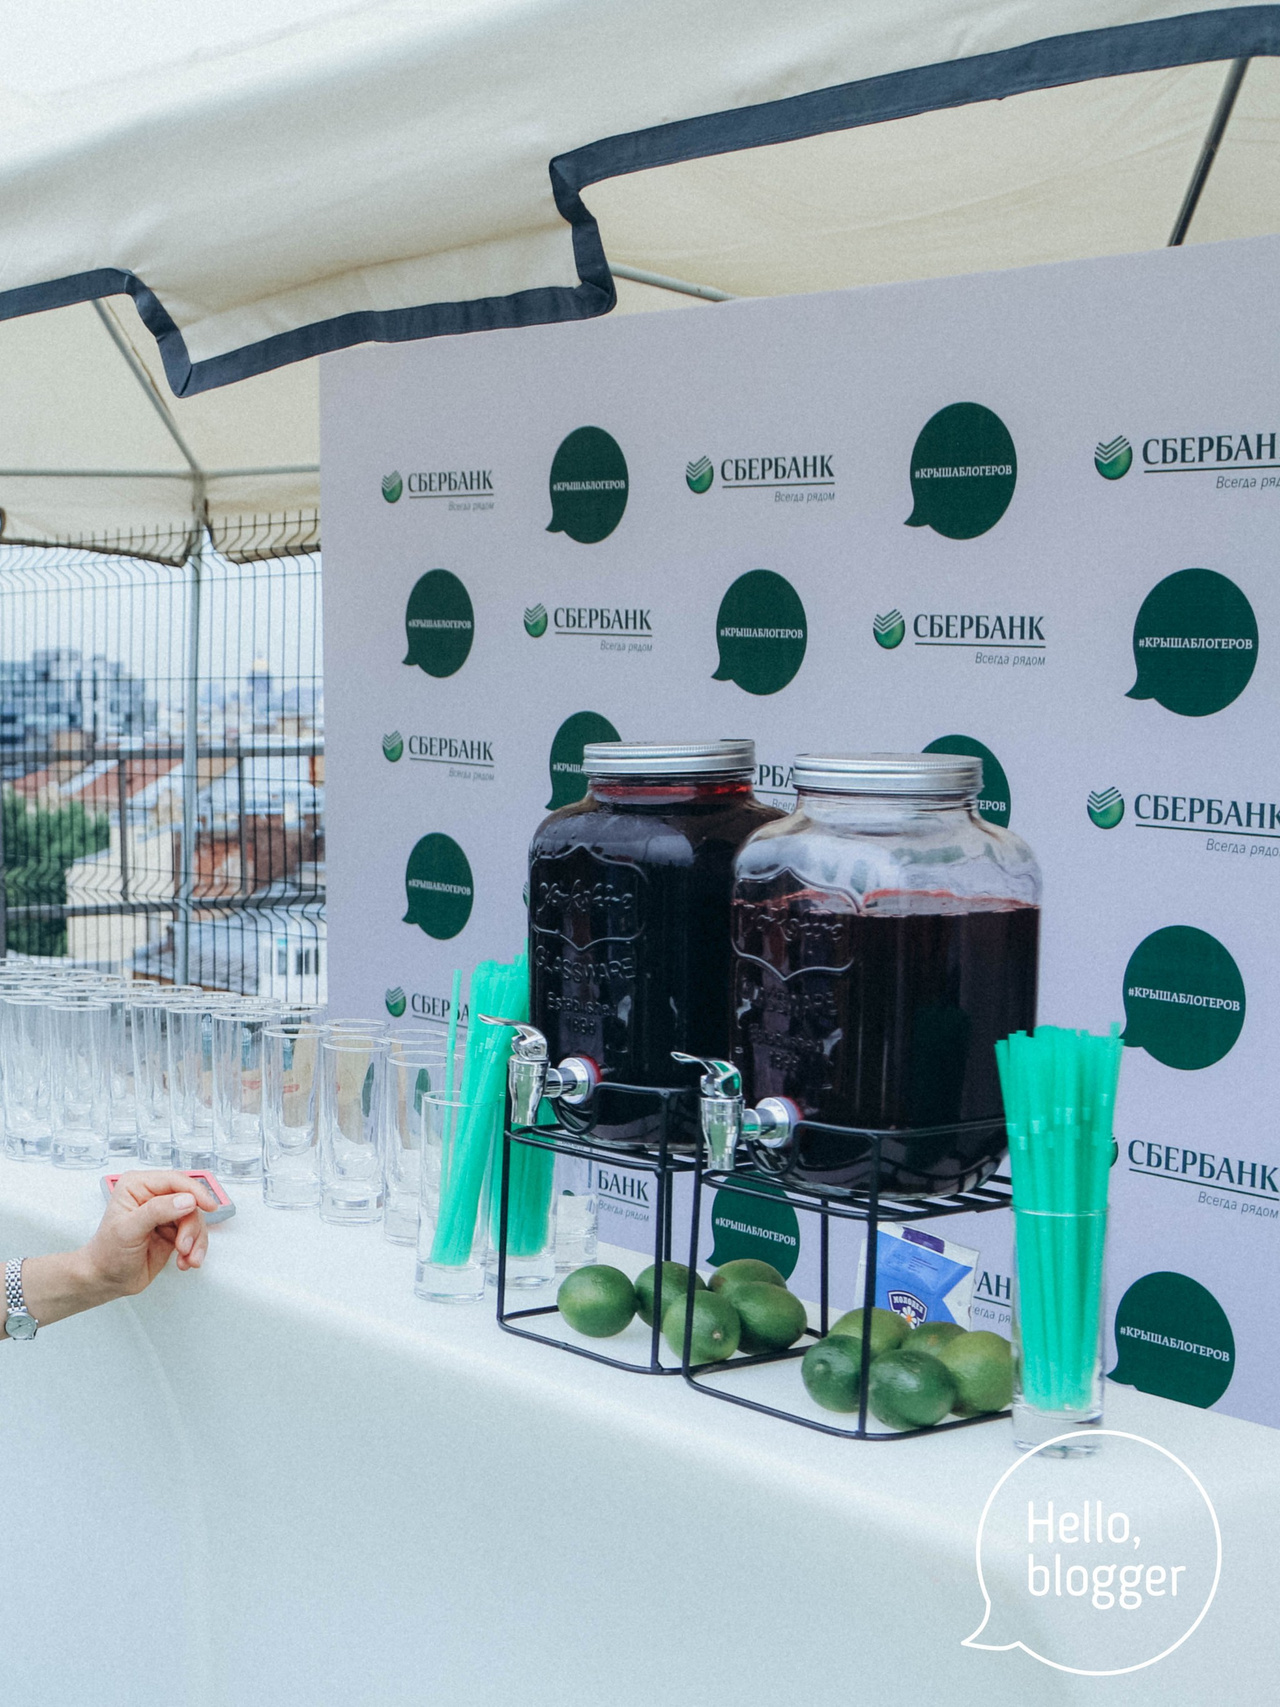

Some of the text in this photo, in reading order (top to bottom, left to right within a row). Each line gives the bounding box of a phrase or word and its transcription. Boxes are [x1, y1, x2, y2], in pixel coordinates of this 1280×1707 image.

[1142, 432, 1278, 466] СБЕРБАН
[721, 454, 834, 482] СБЕРБАНК
[914, 464, 1013, 479] #КРЫШАБЛОГЕРОВ
[407, 470, 493, 493] СБЕРБАНК
[552, 479, 626, 492] #КРЫШАБЛОГЕРОВ
[1216, 475, 1257, 489] Всегда
[774, 490, 835, 503] Всегда рядом
[448, 501, 494, 513] Всегда рядом
[408, 618, 472, 630] #КРЫШАБЛОГЕРОВ
[553, 606, 652, 631] СБЕРБАНК
[913, 613, 1046, 640] СБЕРБАНК
[720, 627, 803, 640] #КРЫШАБЛОГЕРОВ
[600, 639, 653, 653] Всегда рядом
[1138, 636, 1253, 651] #КРЫШАБЛОГЕРОВ
[975, 651, 1046, 667] Всегда рядом
[408, 735, 494, 762] СБЕРБАНК
[448, 768, 495, 782] Всегда рядом
[772, 798, 795, 812] Всег
[1206, 838, 1280, 857] Всегда рядо
[408, 879, 471, 896] #КРЫШАБЛОГЕРОВ
[1128, 986, 1240, 1012] #КРЫШАБЛОГЕРОВ
[1128, 1139, 1280, 1193] СБЕРБАНК
[598, 1170, 649, 1202] БАНК
[1198, 1191, 1279, 1219] Всегда рядом
[624, 1208, 650, 1222] рядом
[715, 1217, 797, 1246] #КРЫШАБЛОГЕРОВ
[973, 1306, 996, 1320] егда
[1119, 1325, 1230, 1362] #КРЫШАБЛОГЕРОВ
